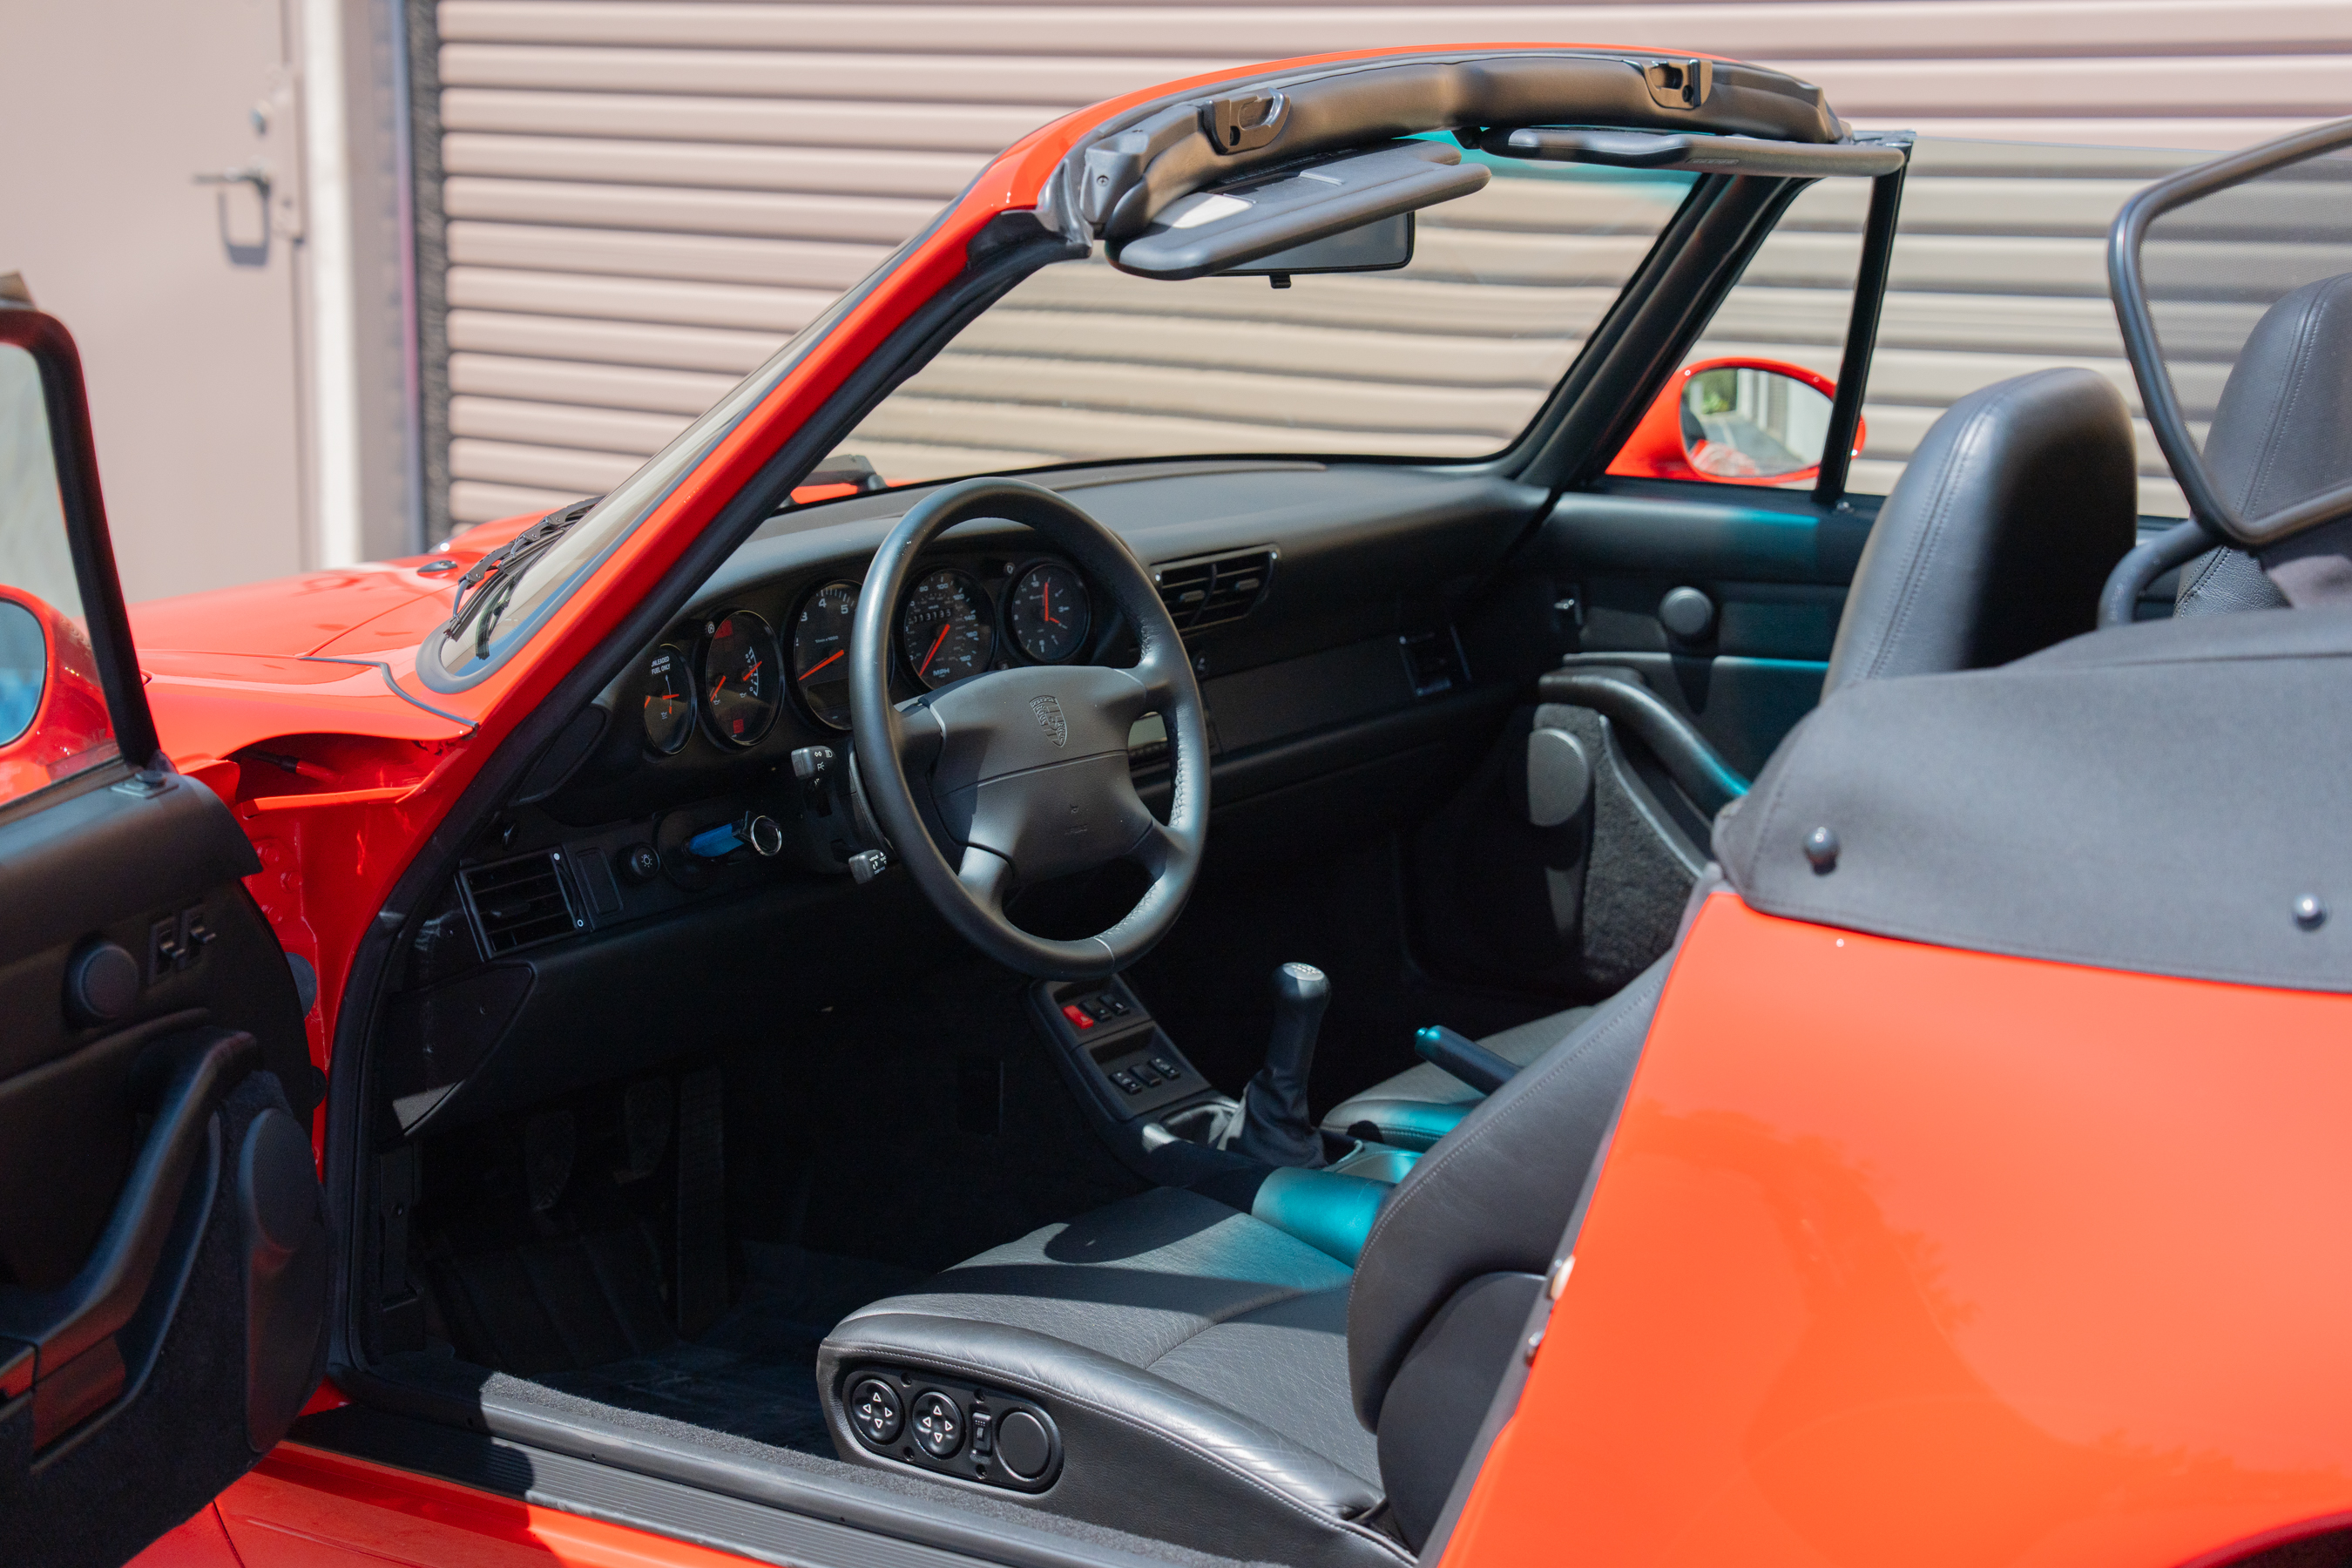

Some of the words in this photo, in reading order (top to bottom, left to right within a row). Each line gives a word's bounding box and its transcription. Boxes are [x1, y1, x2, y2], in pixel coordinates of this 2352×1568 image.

[819, 598, 827, 608] 4
[841, 604, 848, 614] 5
[801, 612, 808, 622] 3
[660, 663, 671, 672] ONLY
[932, 667, 950, 676] MPH
